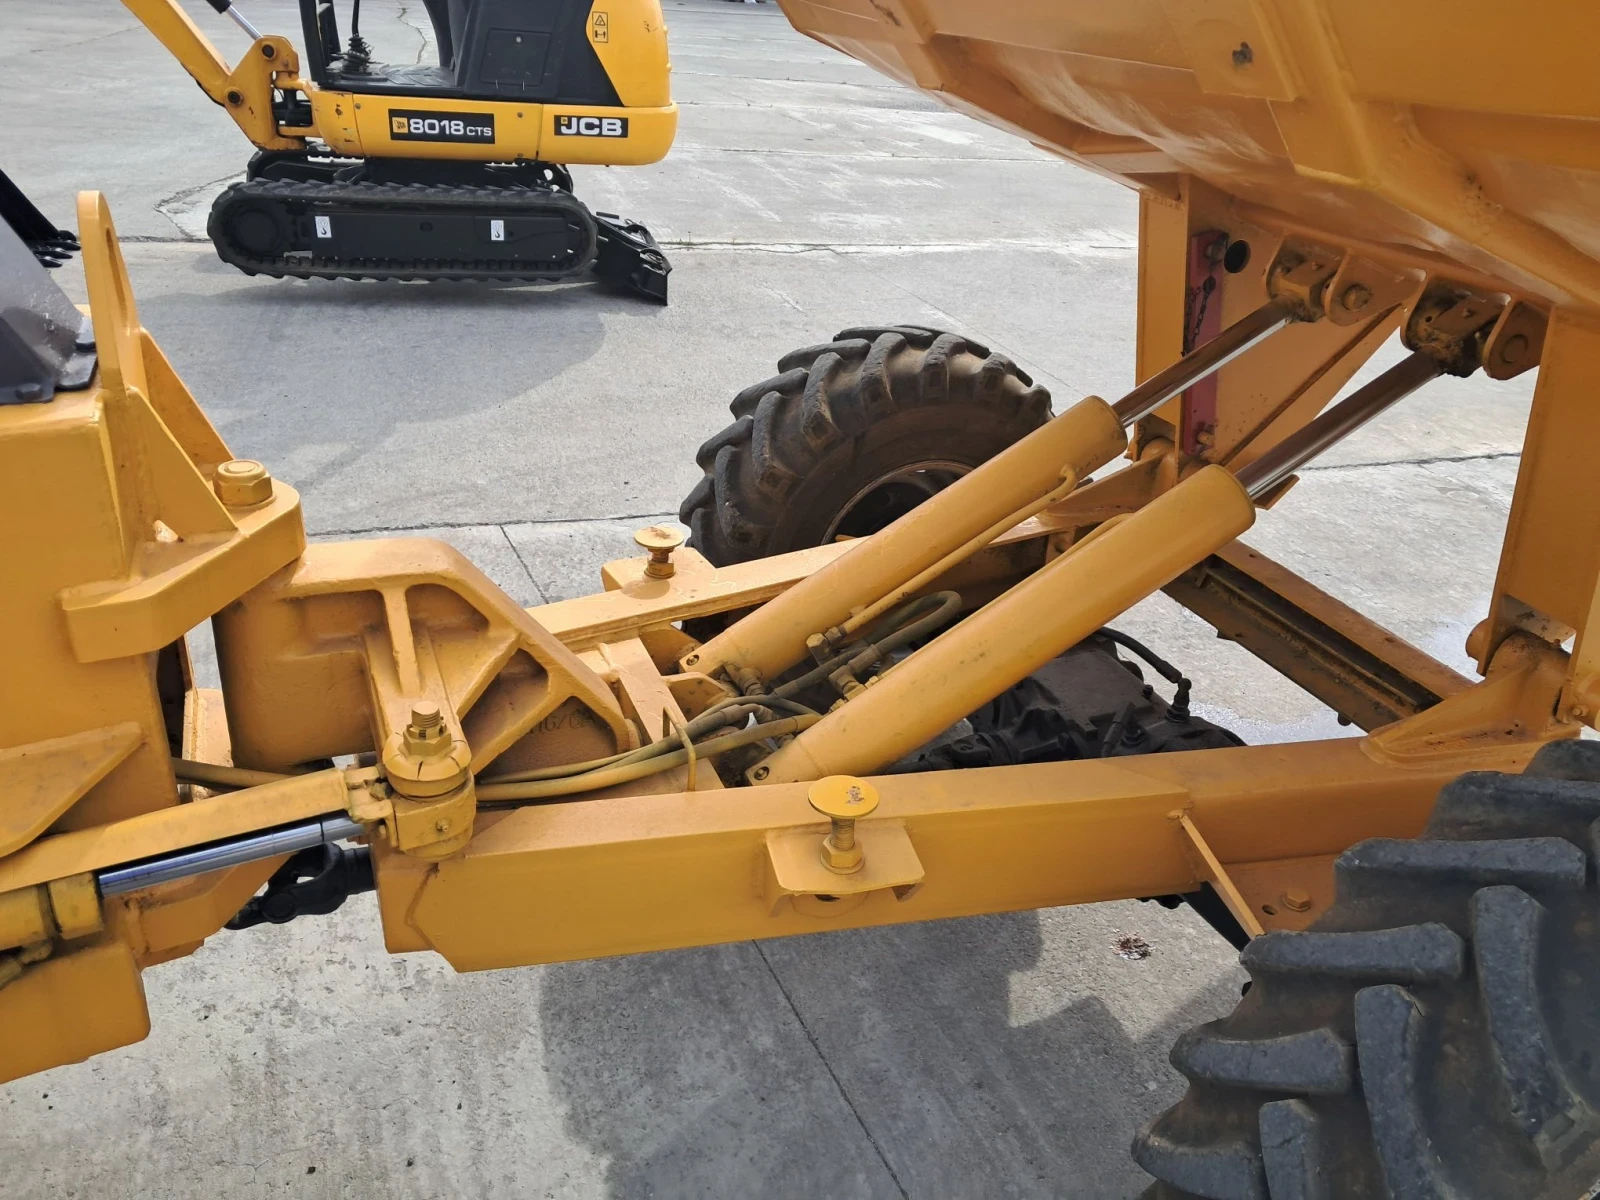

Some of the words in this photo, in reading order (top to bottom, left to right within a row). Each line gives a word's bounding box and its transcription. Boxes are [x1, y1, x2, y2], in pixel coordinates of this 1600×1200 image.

[409, 118, 465, 135] 8018
[466, 126, 492, 136] CTS
[560, 116, 622, 136] JCB
